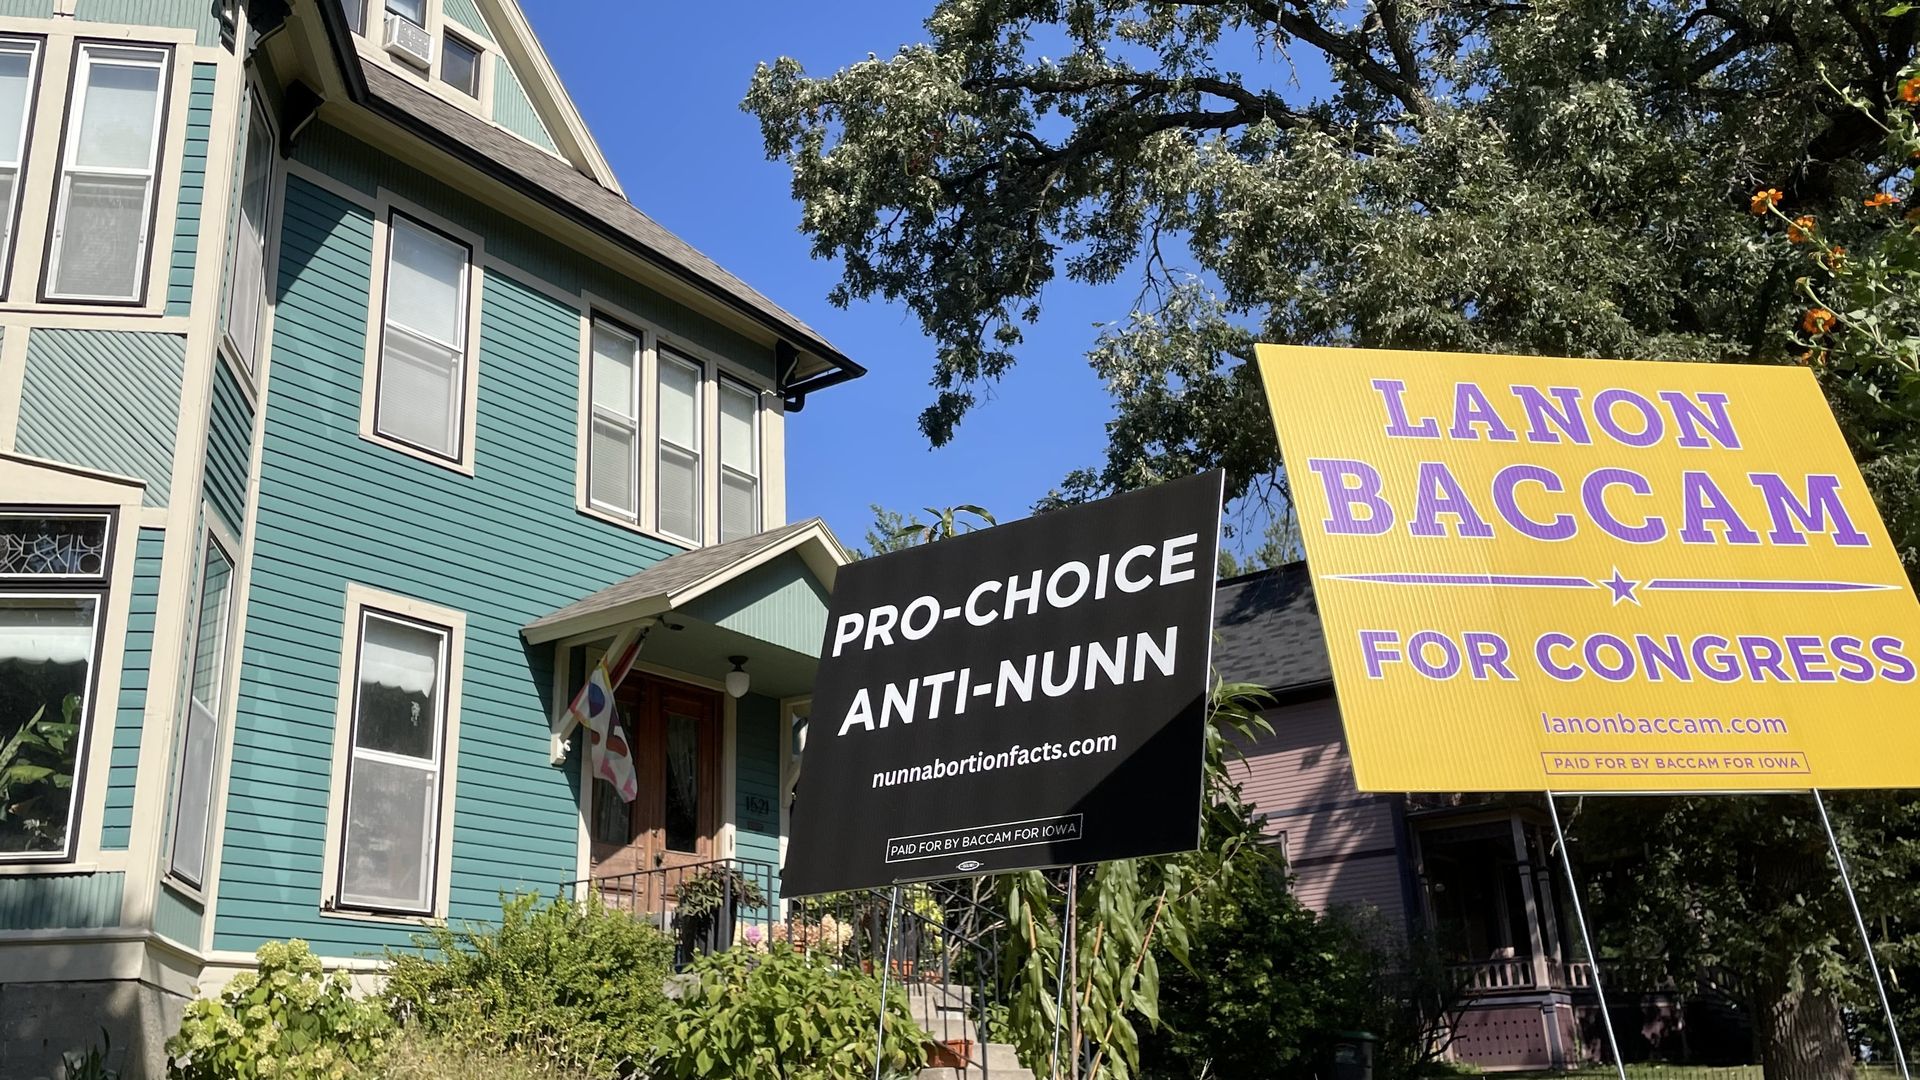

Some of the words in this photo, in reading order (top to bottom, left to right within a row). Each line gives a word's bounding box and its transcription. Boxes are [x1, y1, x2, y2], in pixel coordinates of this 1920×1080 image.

[1371, 378, 1743, 450] LANON
[1307, 458, 1872, 548] BACCAM
[832, 533, 1198, 658] PRO-CHOICE
[837, 626, 1178, 736] ANTI-NUNN
[1358, 629, 1520, 682] FOR
[1534, 631, 1917, 684] CONGRESS
[1541, 711, 1788, 735] lanonbaccam.com
[872, 734, 1117, 789] nunnabortionfacts.com
[1554, 757, 1590, 769] PAID
[1595, 758, 1627, 769] FOR
[1631, 758, 1650, 769] BY
[1655, 757, 1719, 769] BACCAM
[1723, 757, 1755, 769] FOR
[1759, 757, 1800, 769] IOWA
[890, 843, 917, 857] PAID
[918, 840, 942, 853] FOR
[944, 837, 960, 850] BY
[962, 830, 1012, 848] BACCAM
[1014, 827, 1039, 841] FOR
[1042, 822, 1076, 838] IOWA
